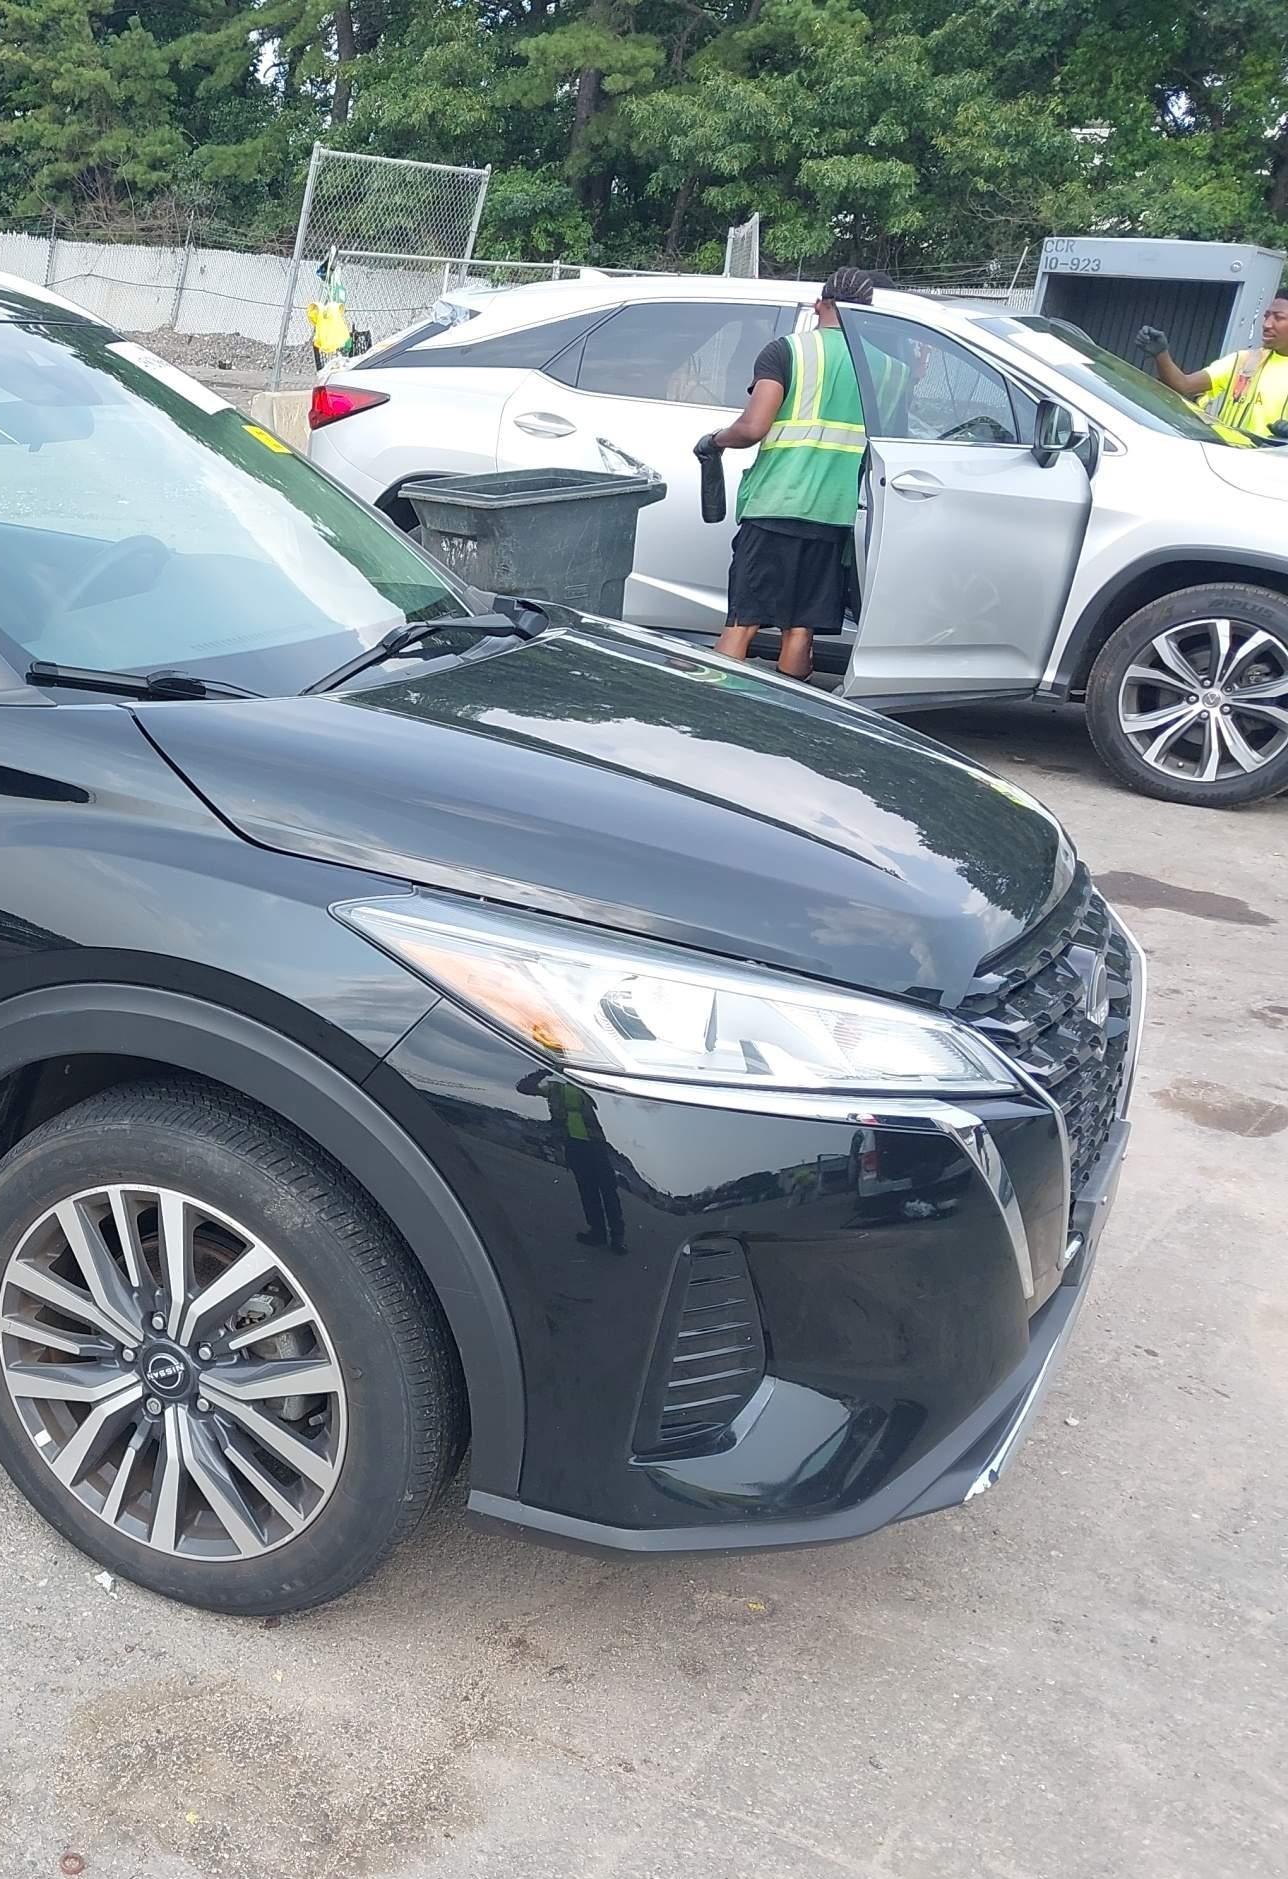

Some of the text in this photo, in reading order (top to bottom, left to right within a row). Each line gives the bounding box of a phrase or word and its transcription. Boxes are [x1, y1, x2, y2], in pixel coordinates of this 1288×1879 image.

[1044, 239, 1076, 253] CCR
[1043, 256, 1102, 272] 10-923
[146, 1362, 185, 1380] NISSAN
